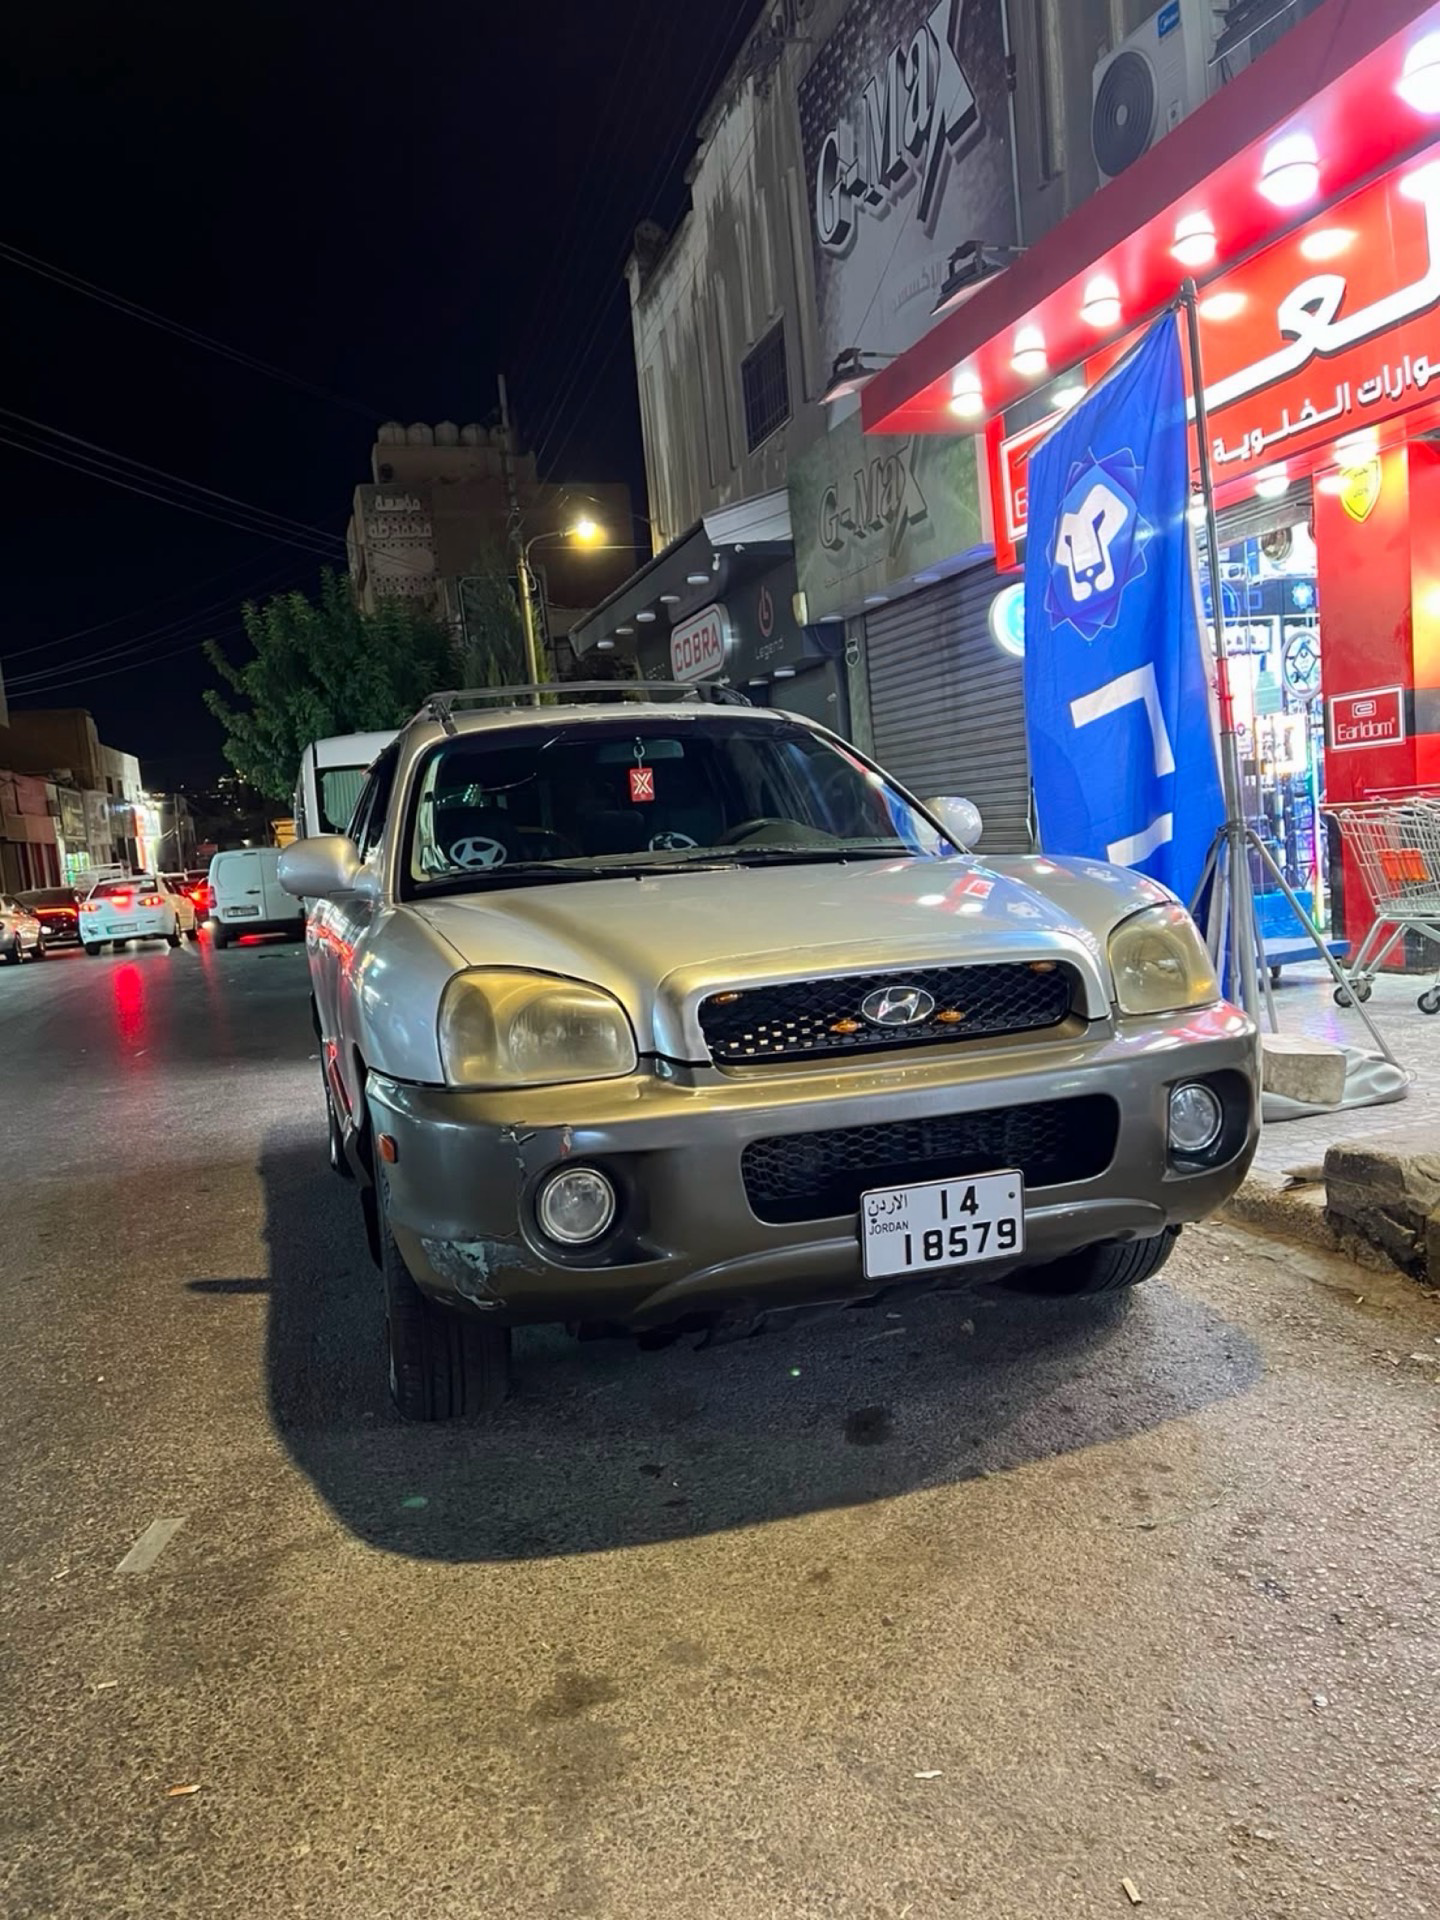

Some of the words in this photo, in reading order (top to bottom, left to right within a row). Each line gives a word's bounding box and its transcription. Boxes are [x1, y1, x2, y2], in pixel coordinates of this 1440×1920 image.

[817, 0, 978, 245] G-Max
[1212, 382, 1350, 464] الخلوية
[820, 434, 928, 557] G-Max
[673, 623, 721, 672] COBRA
[1337, 720, 1393, 741] Earldom
[940, 1185, 980, 1220] 14
[869, 1220, 909, 1235] JORDAN
[904, 1217, 1017, 1266] 18579
